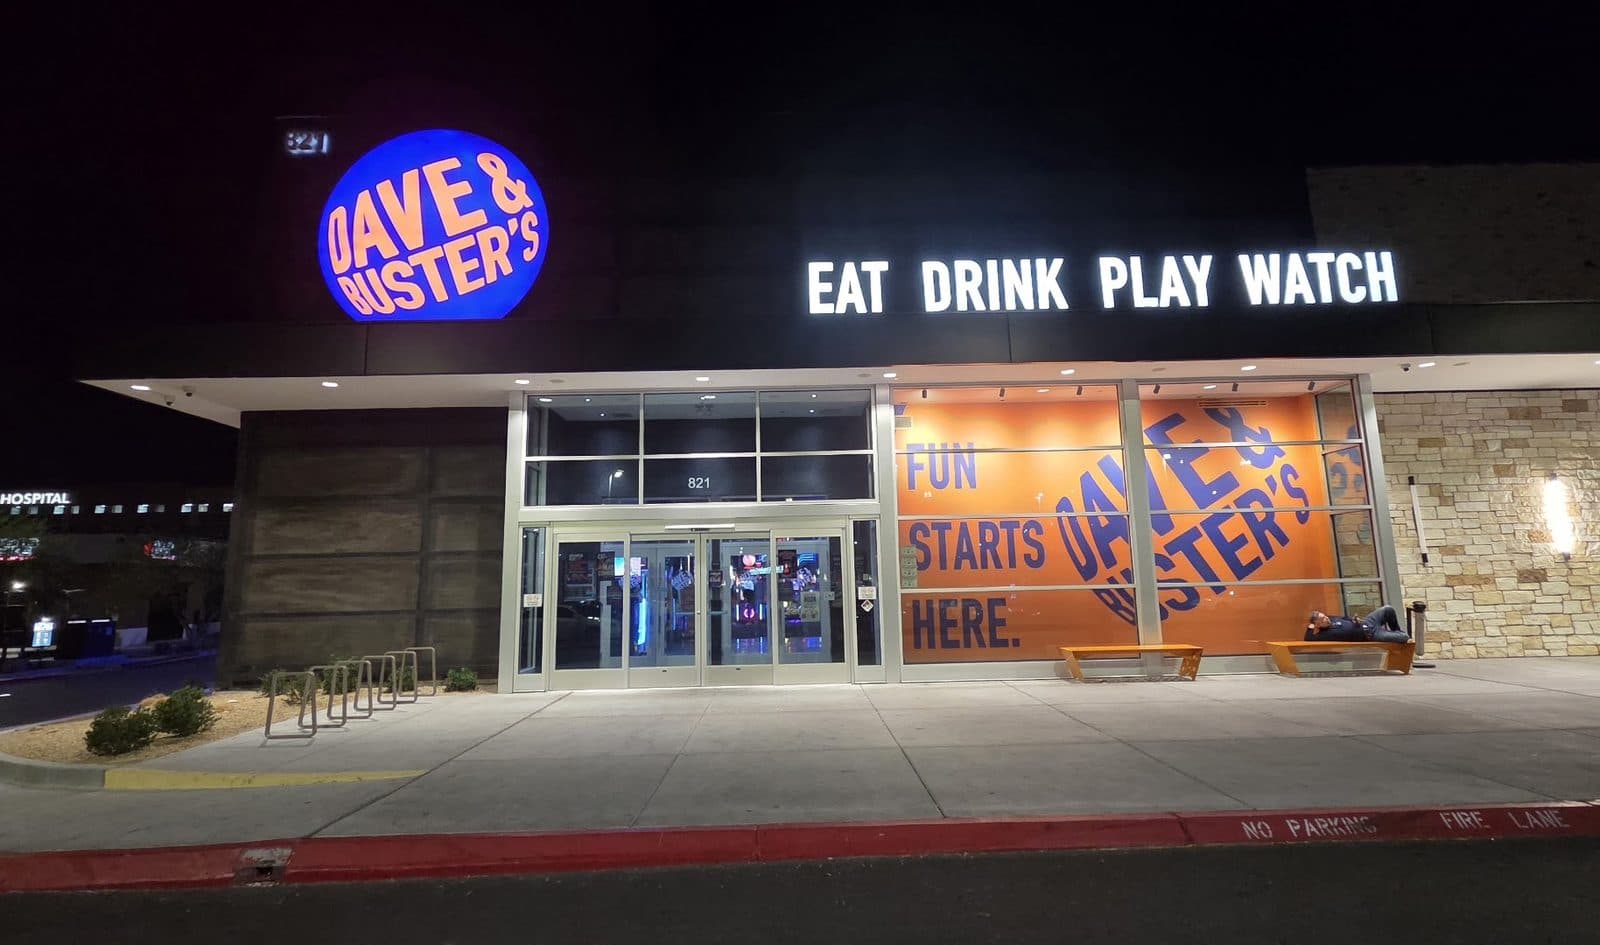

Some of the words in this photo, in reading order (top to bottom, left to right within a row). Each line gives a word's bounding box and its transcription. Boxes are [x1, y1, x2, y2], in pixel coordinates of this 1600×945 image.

[328, 157, 488, 275] DAVE
[477, 152, 534, 214] &
[337, 211, 539, 315] BUSTER'S
[807, 260, 889, 314] EAT
[922, 257, 1070, 313] DRINK
[1099, 253, 1212, 309] PLAY
[1239, 250, 1399, 306] WATCH
[1203, 406, 1286, 470] &
[688, 477, 710, 489] 821
[906, 442, 977, 490] FUN
[0, 492, 71, 505] HOSPITAL
[909, 519, 1046, 571] STARTS
[912, 597, 1021, 650] HERE.
[1241, 820, 1273, 840] NO
[1285, 815, 1377, 838] PARKING
[1439, 810, 1491, 830] FIRE
[1507, 809, 1571, 829] LANE
